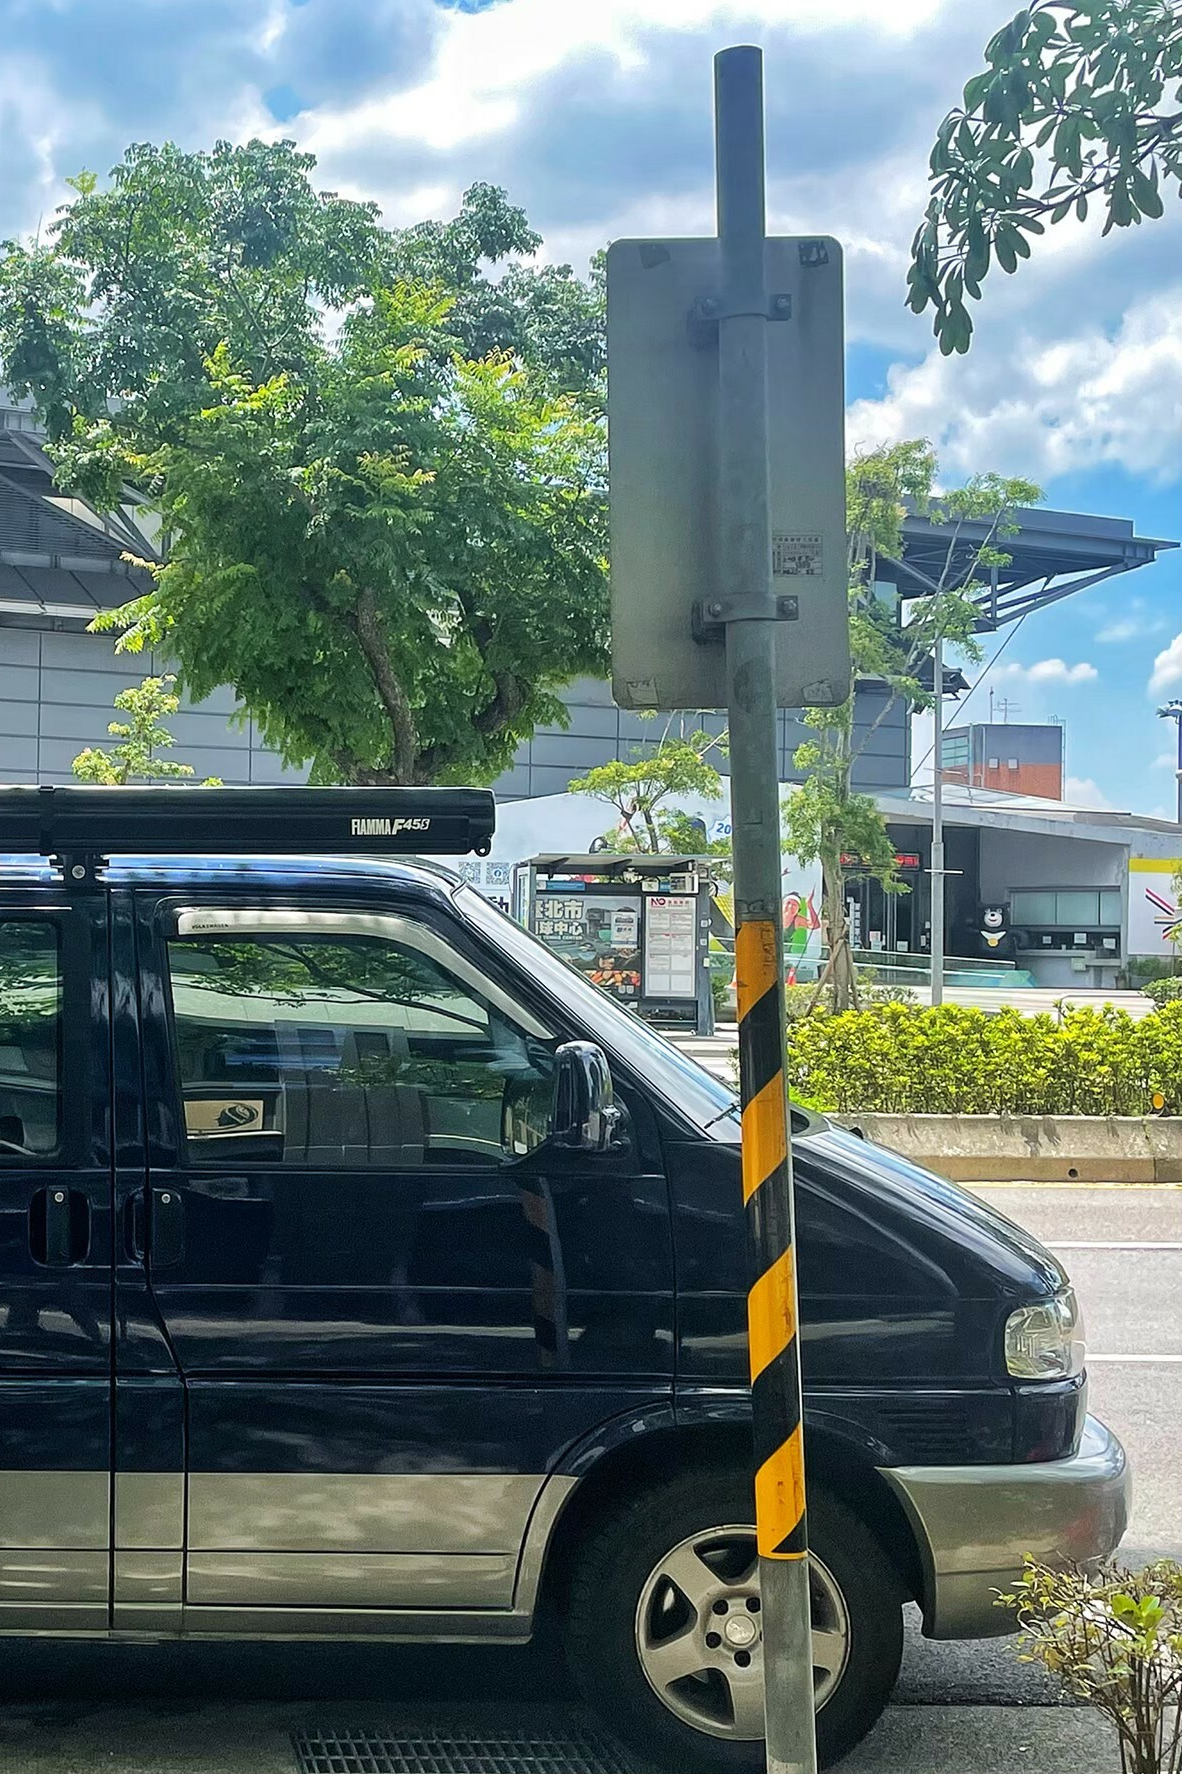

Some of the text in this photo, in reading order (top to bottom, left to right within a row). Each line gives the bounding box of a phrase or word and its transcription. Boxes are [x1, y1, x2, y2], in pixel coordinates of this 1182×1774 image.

[351, 818, 391, 836] FIAMMA
[650, 897, 666, 906] NO
[535, 920, 583, 936] 球中心
